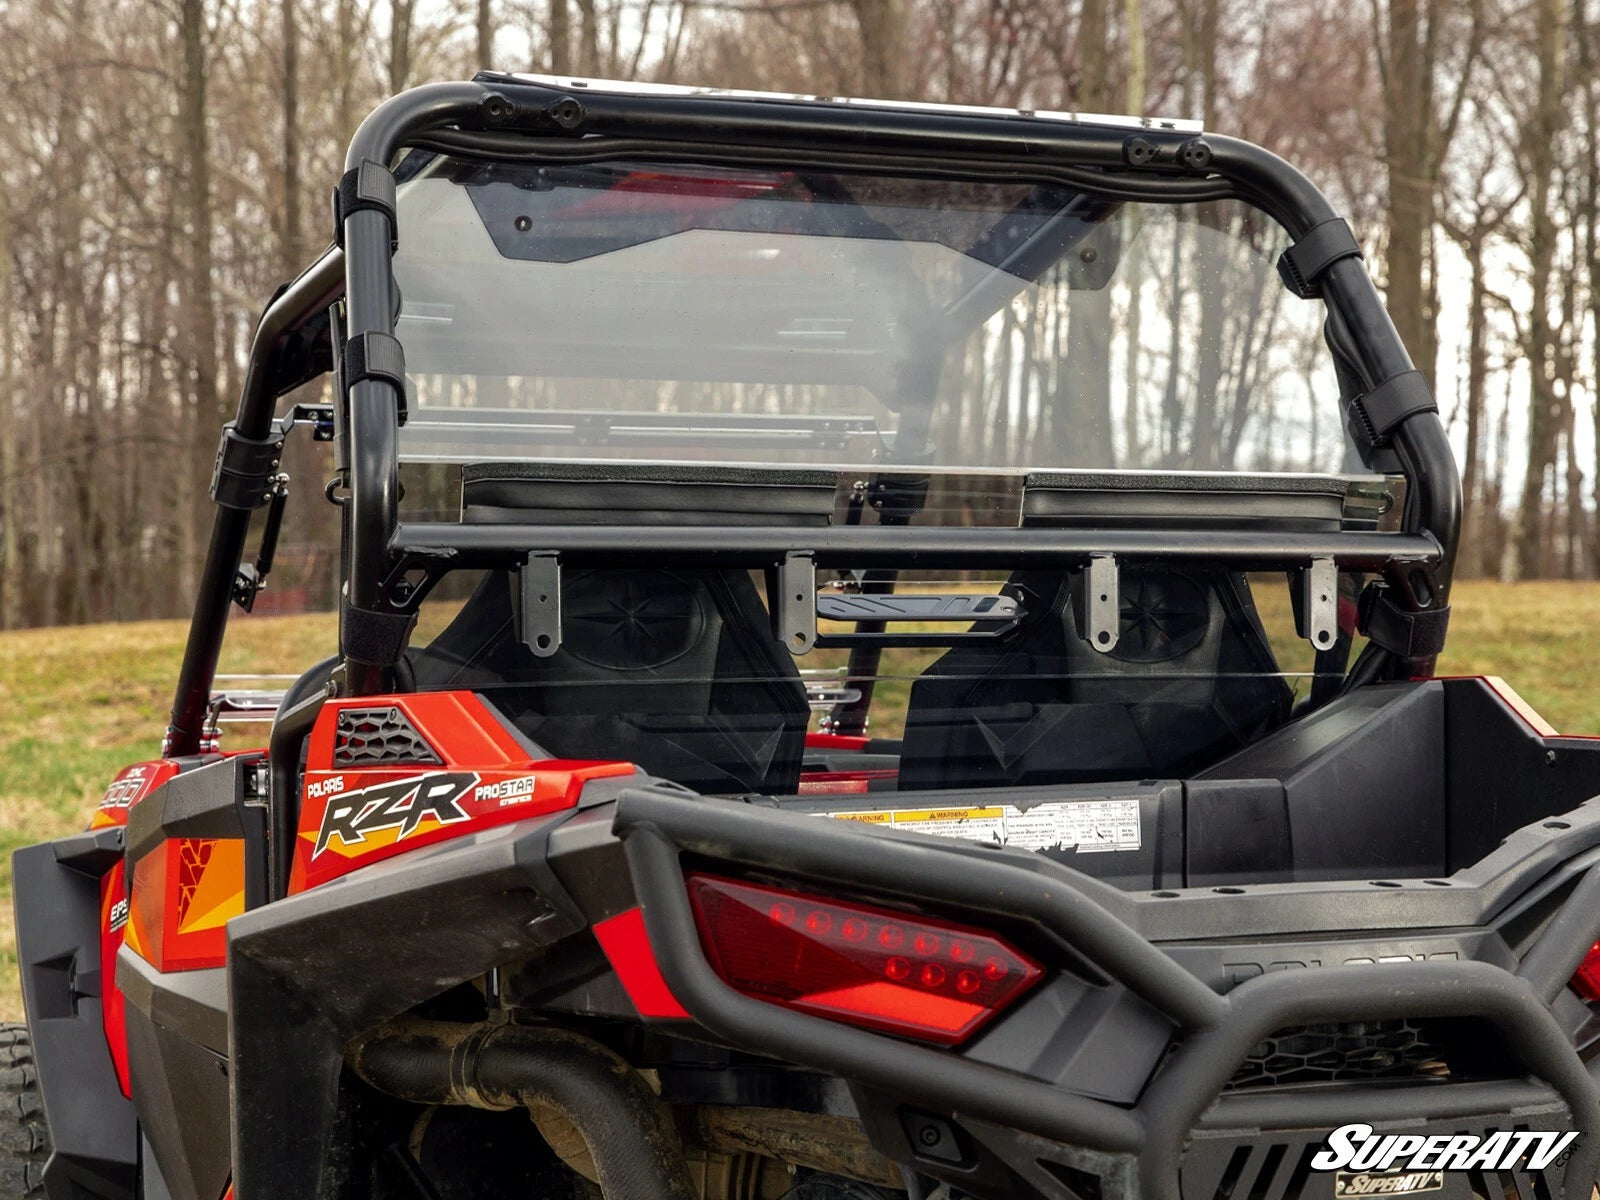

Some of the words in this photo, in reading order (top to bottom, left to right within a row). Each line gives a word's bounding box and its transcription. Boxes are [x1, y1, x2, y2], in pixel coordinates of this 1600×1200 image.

[308, 776, 344, 799] POLARIS
[474, 777, 535, 802] PROSTAR
[311, 771, 482, 862] RZR
[936, 811, 969, 819] WARNING
